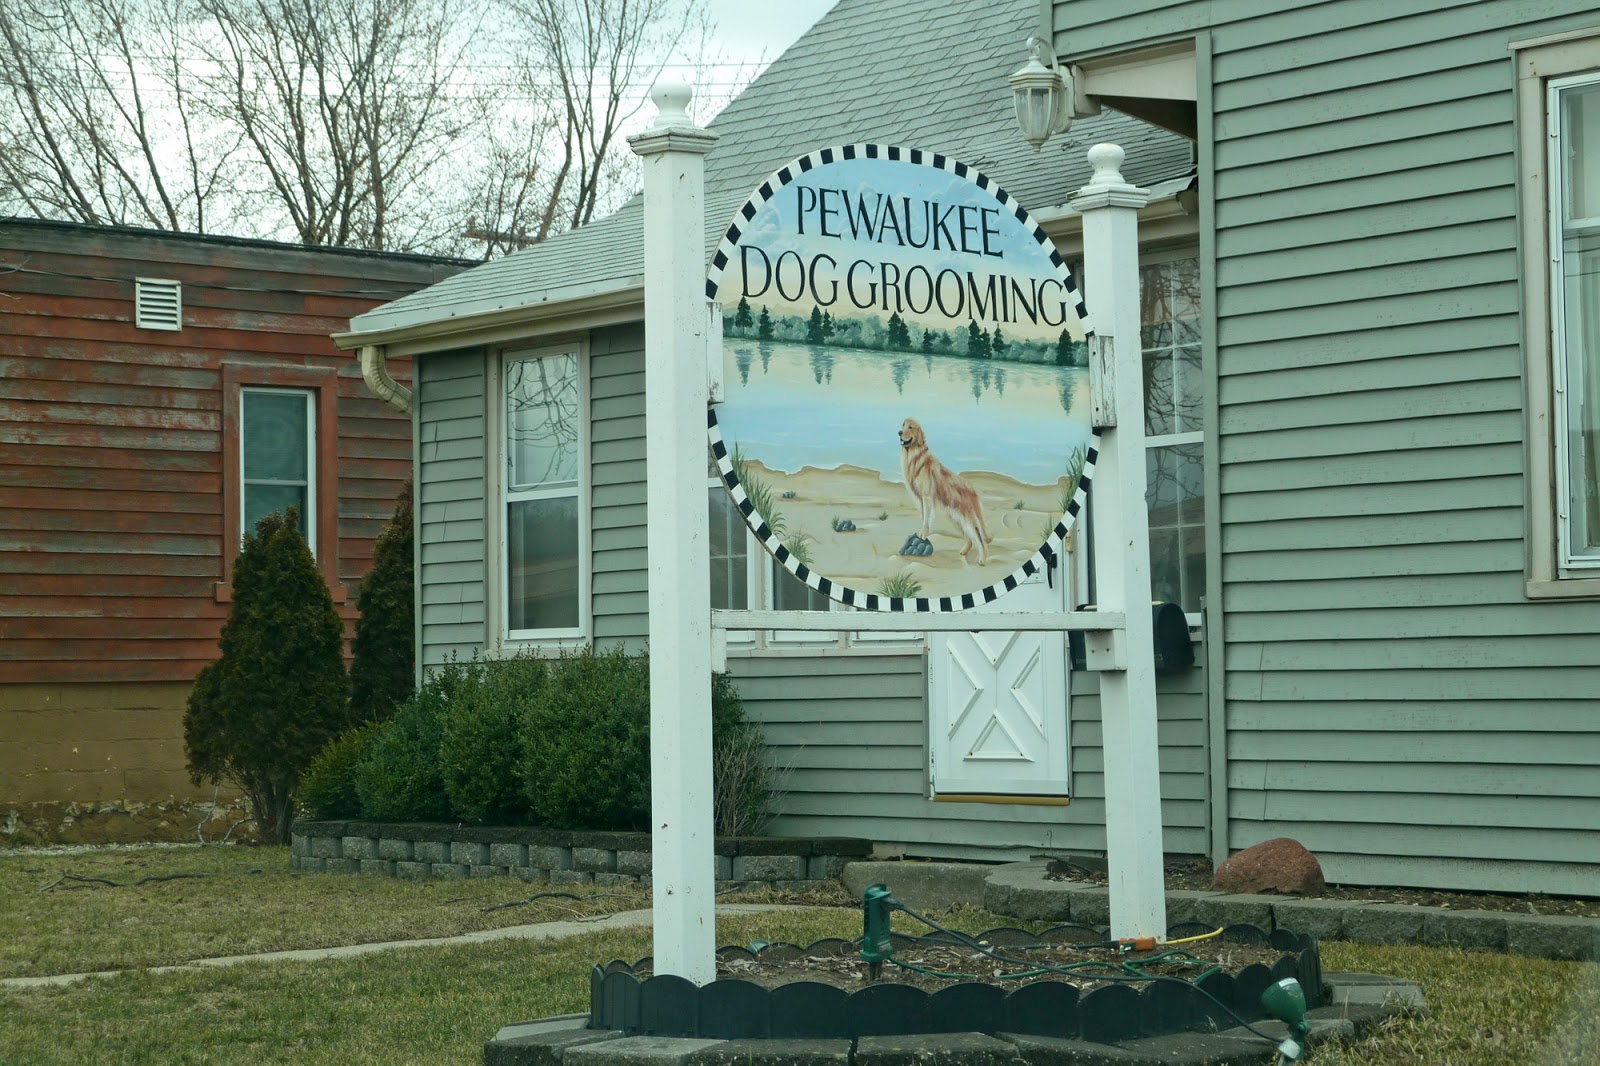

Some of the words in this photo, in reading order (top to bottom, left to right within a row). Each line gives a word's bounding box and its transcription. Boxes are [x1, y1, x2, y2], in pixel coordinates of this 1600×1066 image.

[796, 185, 1004, 258] PEWAUKEE
[740, 245, 839, 307] DOG
[847, 259, 1068, 327] GROOMING
